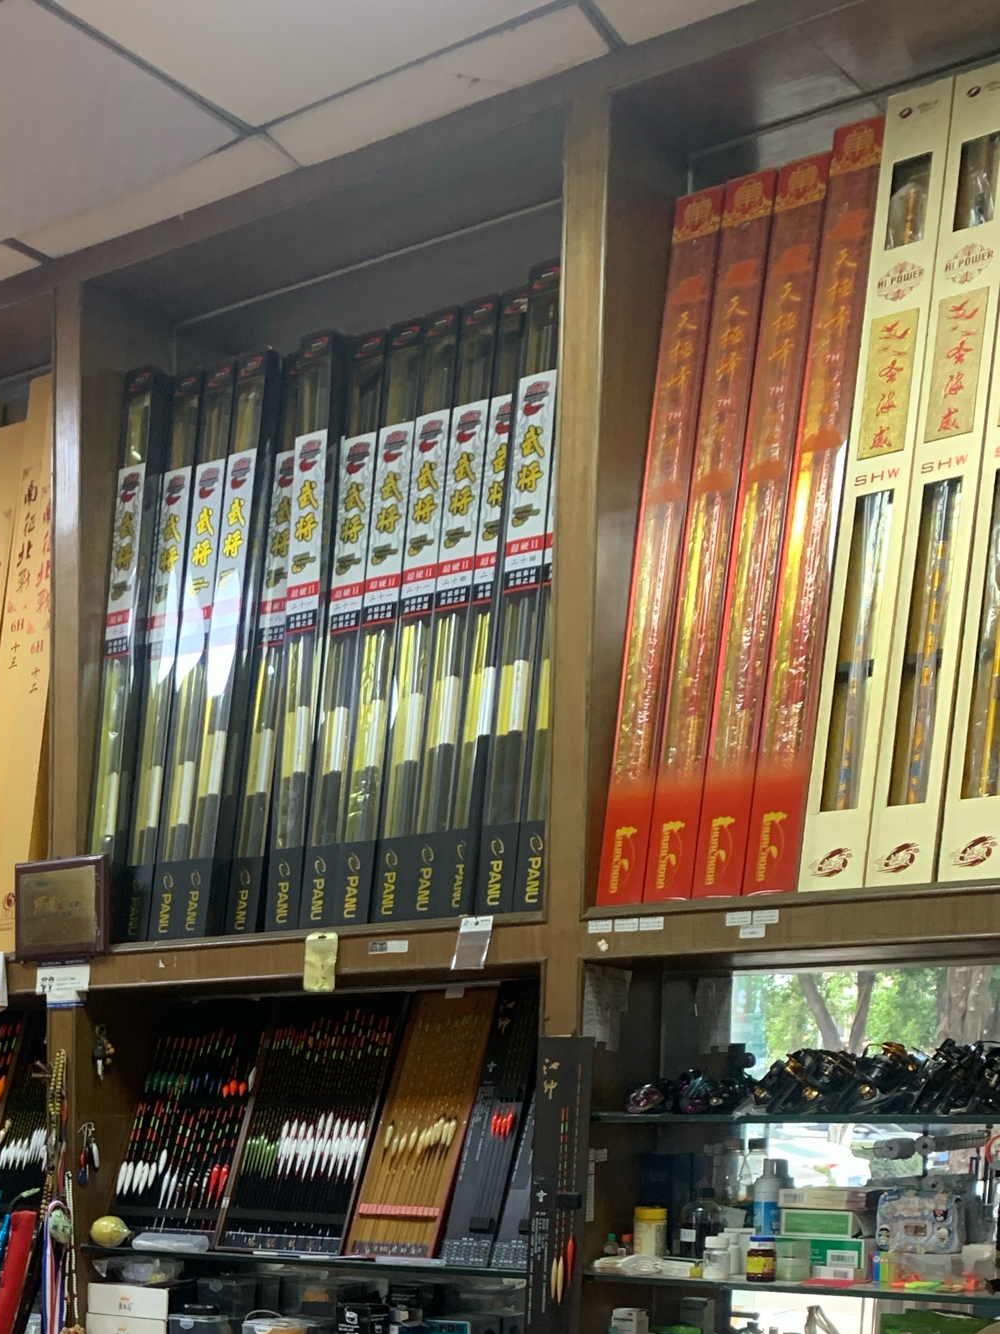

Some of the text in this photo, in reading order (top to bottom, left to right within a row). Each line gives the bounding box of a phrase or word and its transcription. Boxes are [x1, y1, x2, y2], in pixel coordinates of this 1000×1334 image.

[890, 267, 925, 286] POWER
[958, 250, 994, 268] POWER
[854, 466, 902, 488] SHW
[920, 454, 969, 474] SHW
[10, 618, 25, 632] 6H
[30, 640, 44, 654] 6H
[310, 878, 324, 921] PANU
[344, 875, 359, 919] PANU
[382, 871, 398, 915] PANU
[416, 868, 432, 912] PANU
[486, 859, 503, 906] PANU
[524, 856, 542, 904] PANU
[158, 893, 172, 934] PANU
[185, 891, 199, 932] PANU
[234, 889, 248, 930] PANU
[276, 880, 290, 924] PANU
